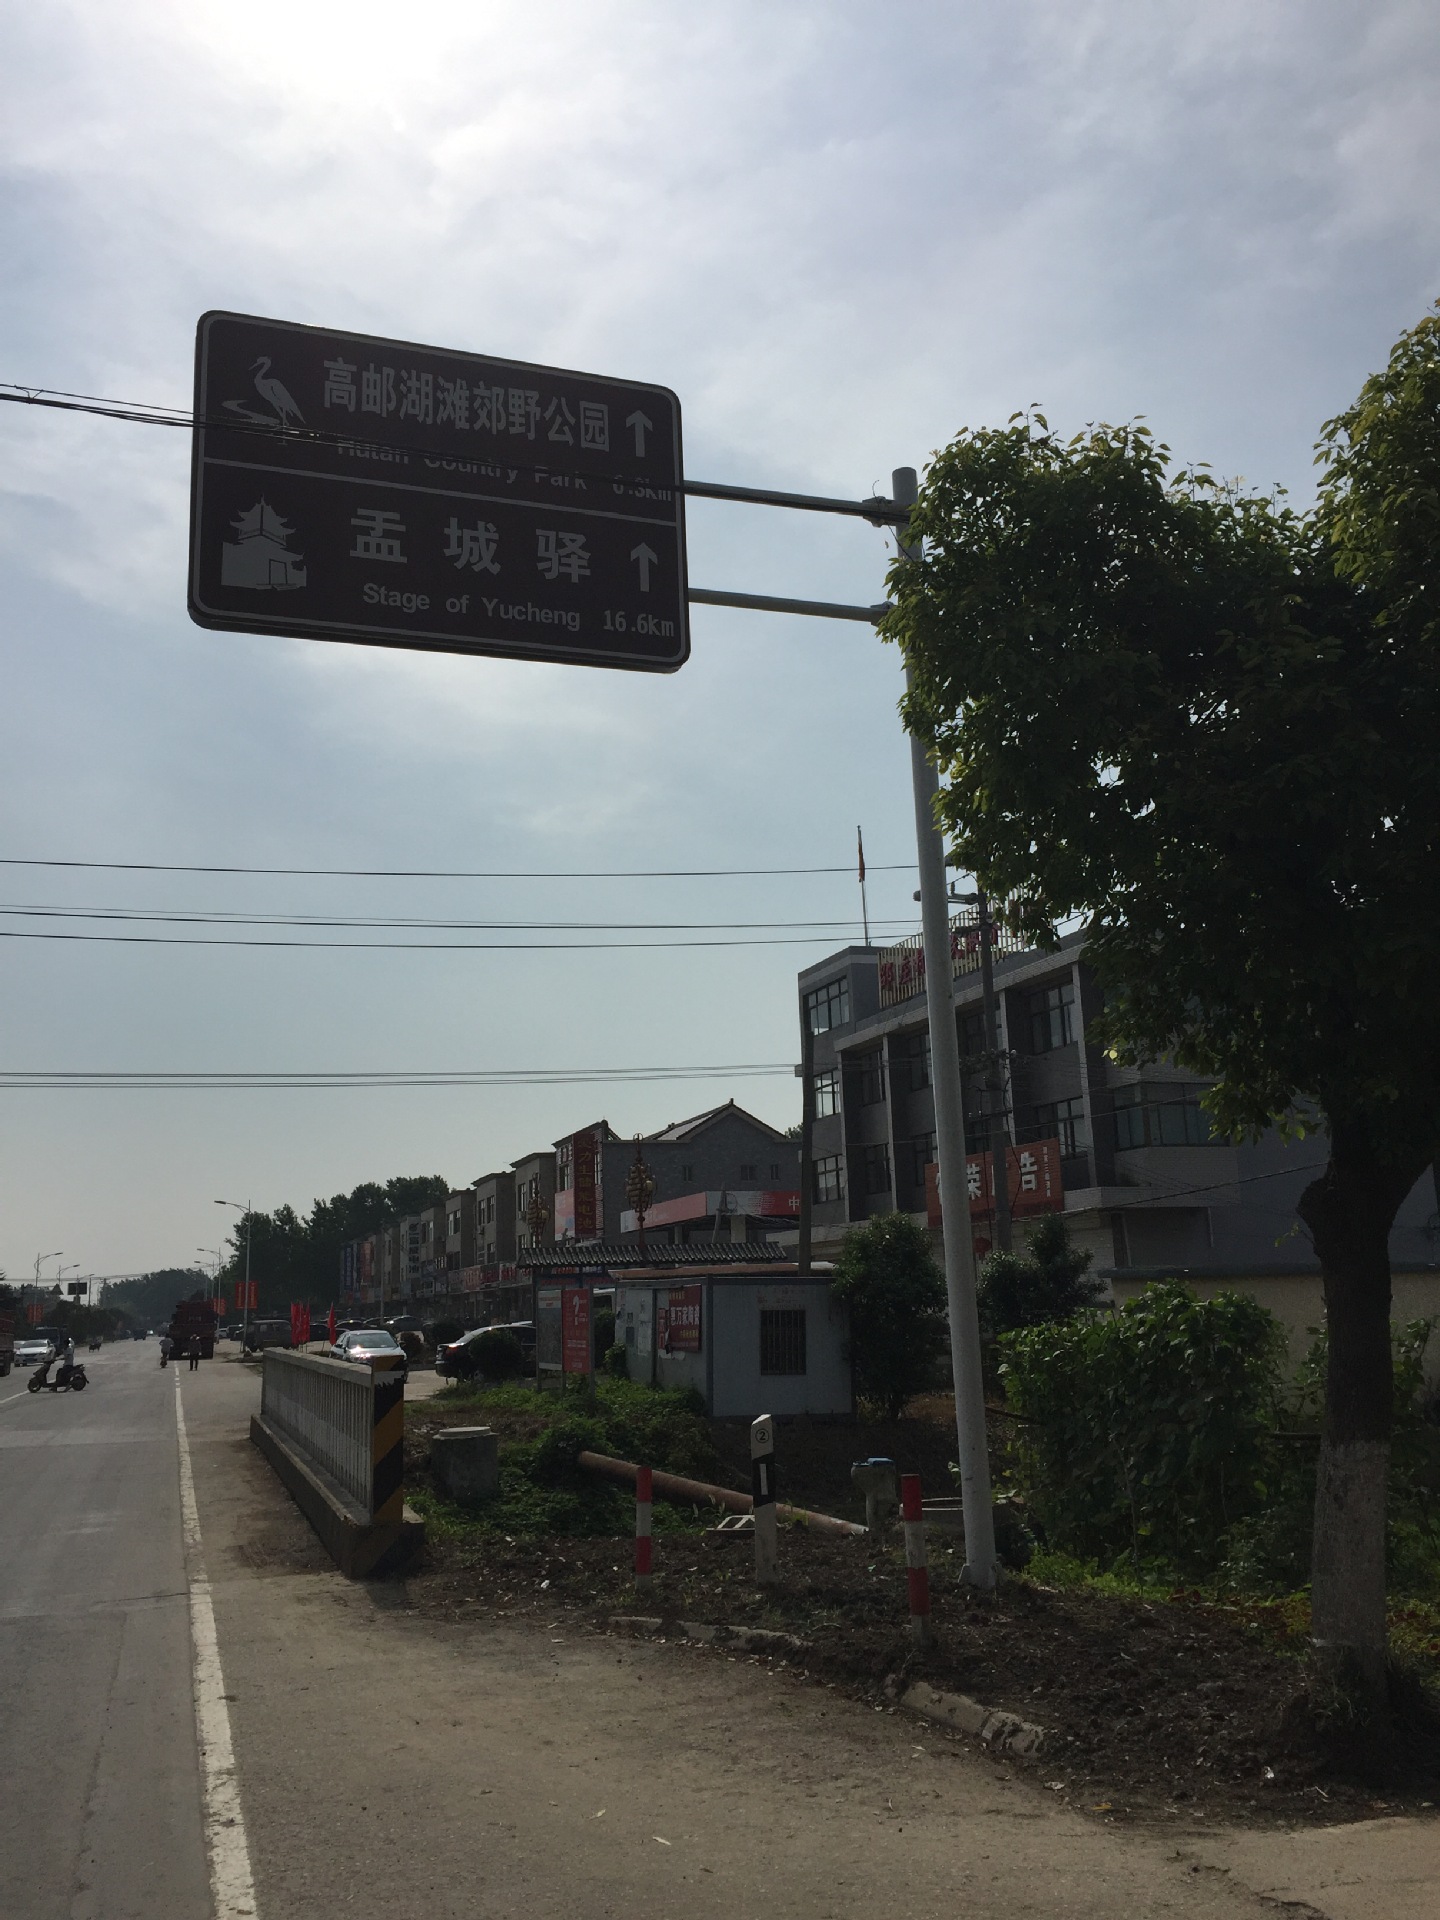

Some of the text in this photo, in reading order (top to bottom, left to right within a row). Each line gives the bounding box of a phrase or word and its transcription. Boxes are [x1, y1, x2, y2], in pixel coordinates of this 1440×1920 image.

[323, 357, 610, 453] 高邮湖滩郊野公园
[349, 508, 592, 584] 盂城驿
[362, 582, 675, 638] Stage of Yucheng 16.6km
